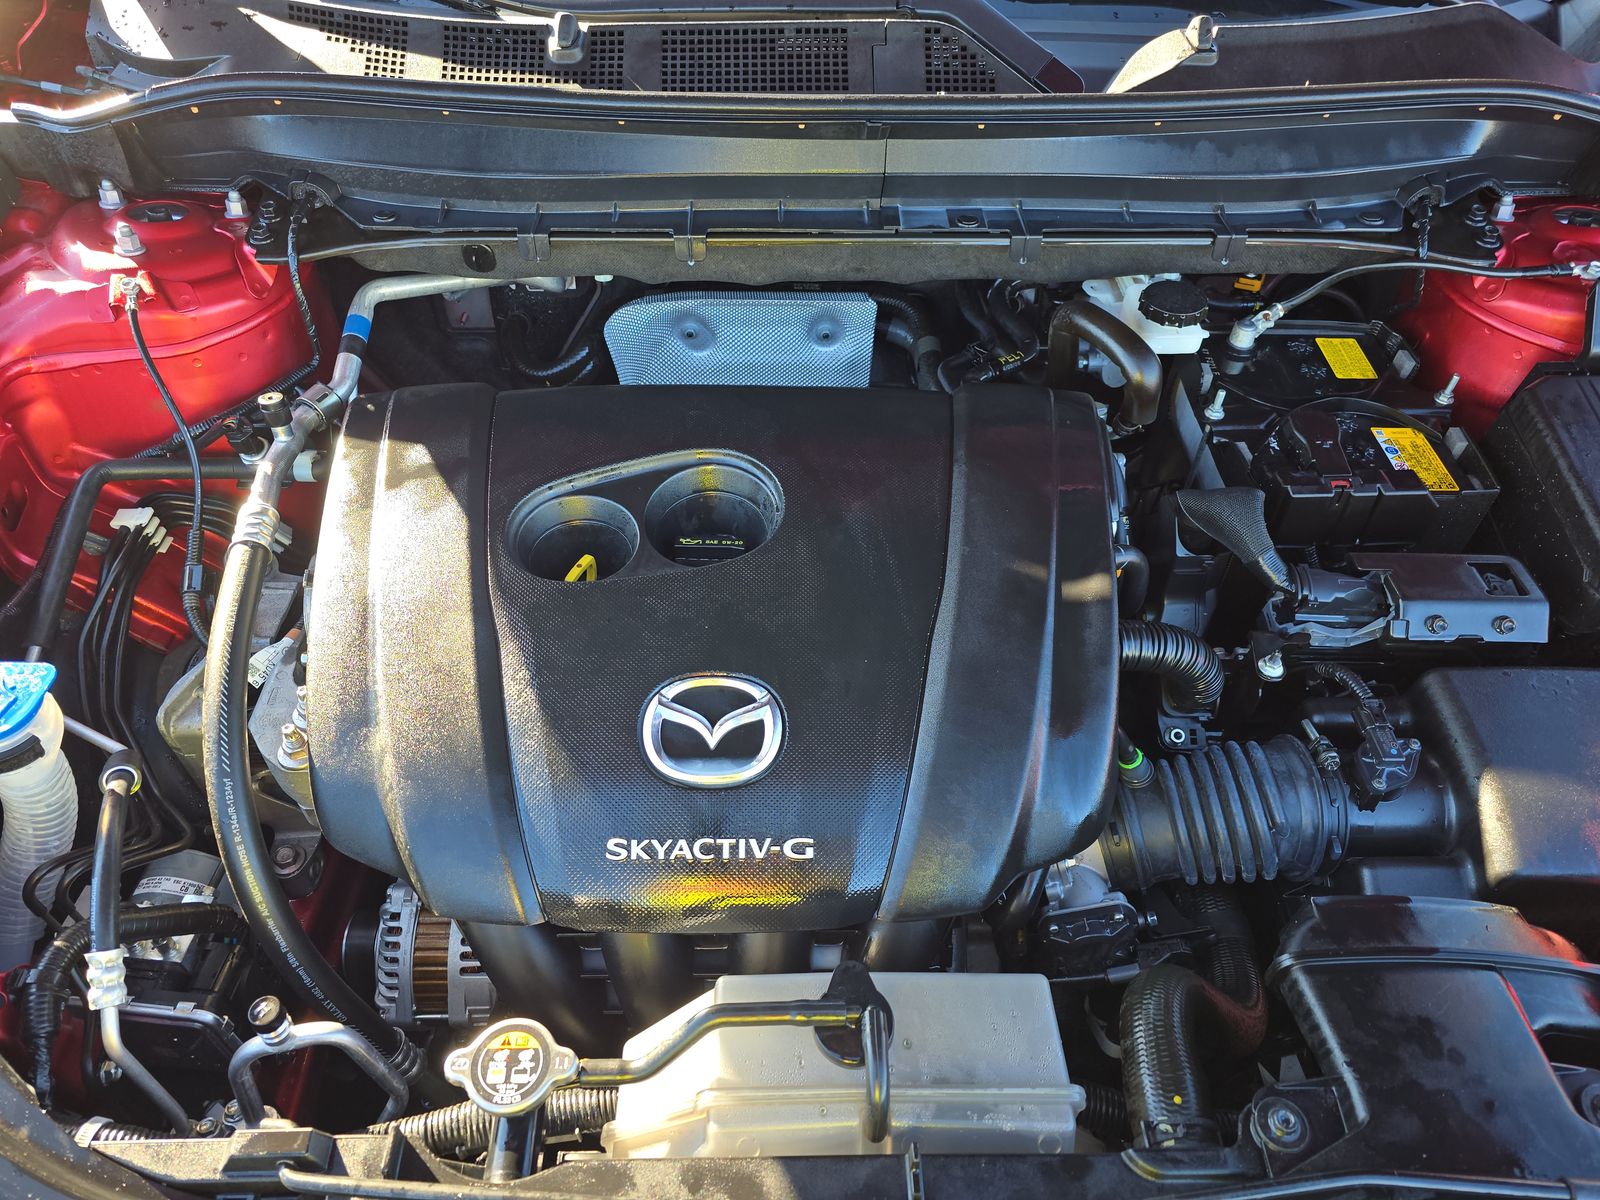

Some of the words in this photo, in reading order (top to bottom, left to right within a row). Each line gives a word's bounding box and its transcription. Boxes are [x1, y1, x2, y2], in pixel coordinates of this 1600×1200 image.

[236, 844, 250, 868] HOSE
[605, 837, 814, 861] SKYACTIV-G
[244, 869, 263, 903] SUCTION
